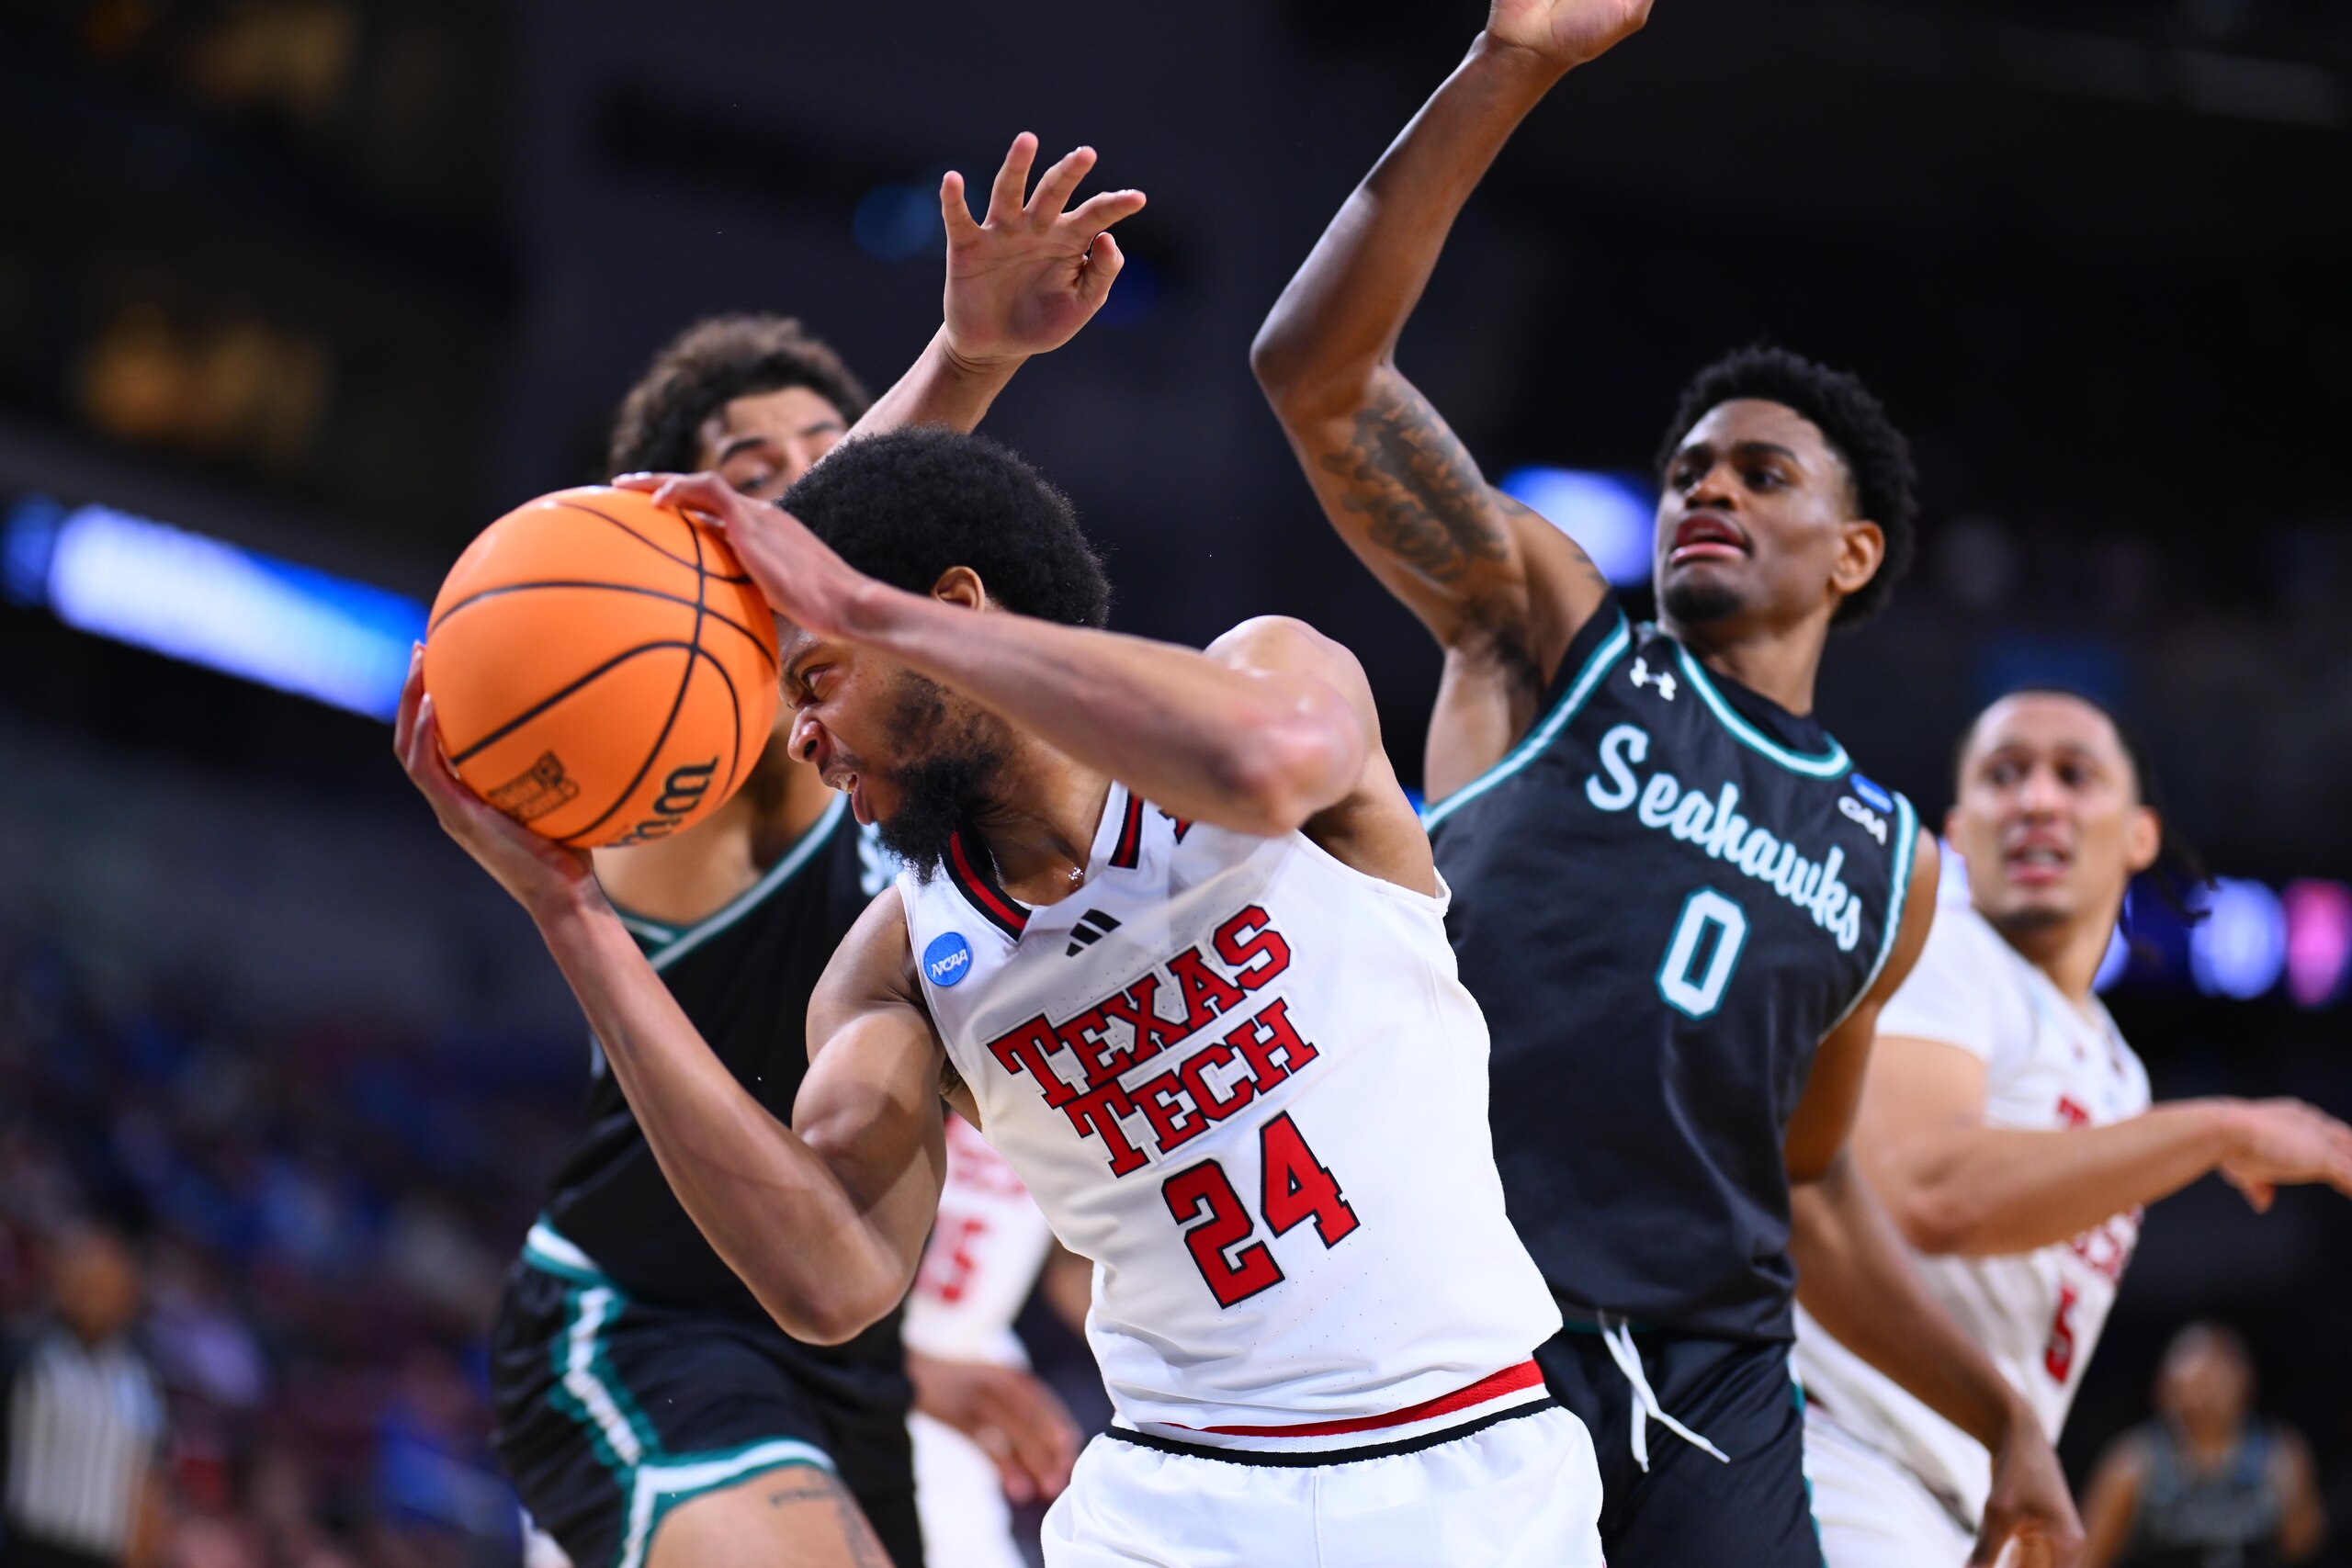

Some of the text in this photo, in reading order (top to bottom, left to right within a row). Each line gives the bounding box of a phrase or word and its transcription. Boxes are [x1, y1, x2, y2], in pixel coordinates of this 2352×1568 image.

[1585, 723, 1862, 952] Seahawks
[931, 948, 969, 978] NCAA
[986, 903, 1292, 1110] TEXAS
[1656, 885, 1750, 1021] 0
[1059, 996, 1320, 1179] TECH
[1160, 1109, 1361, 1310] 24
